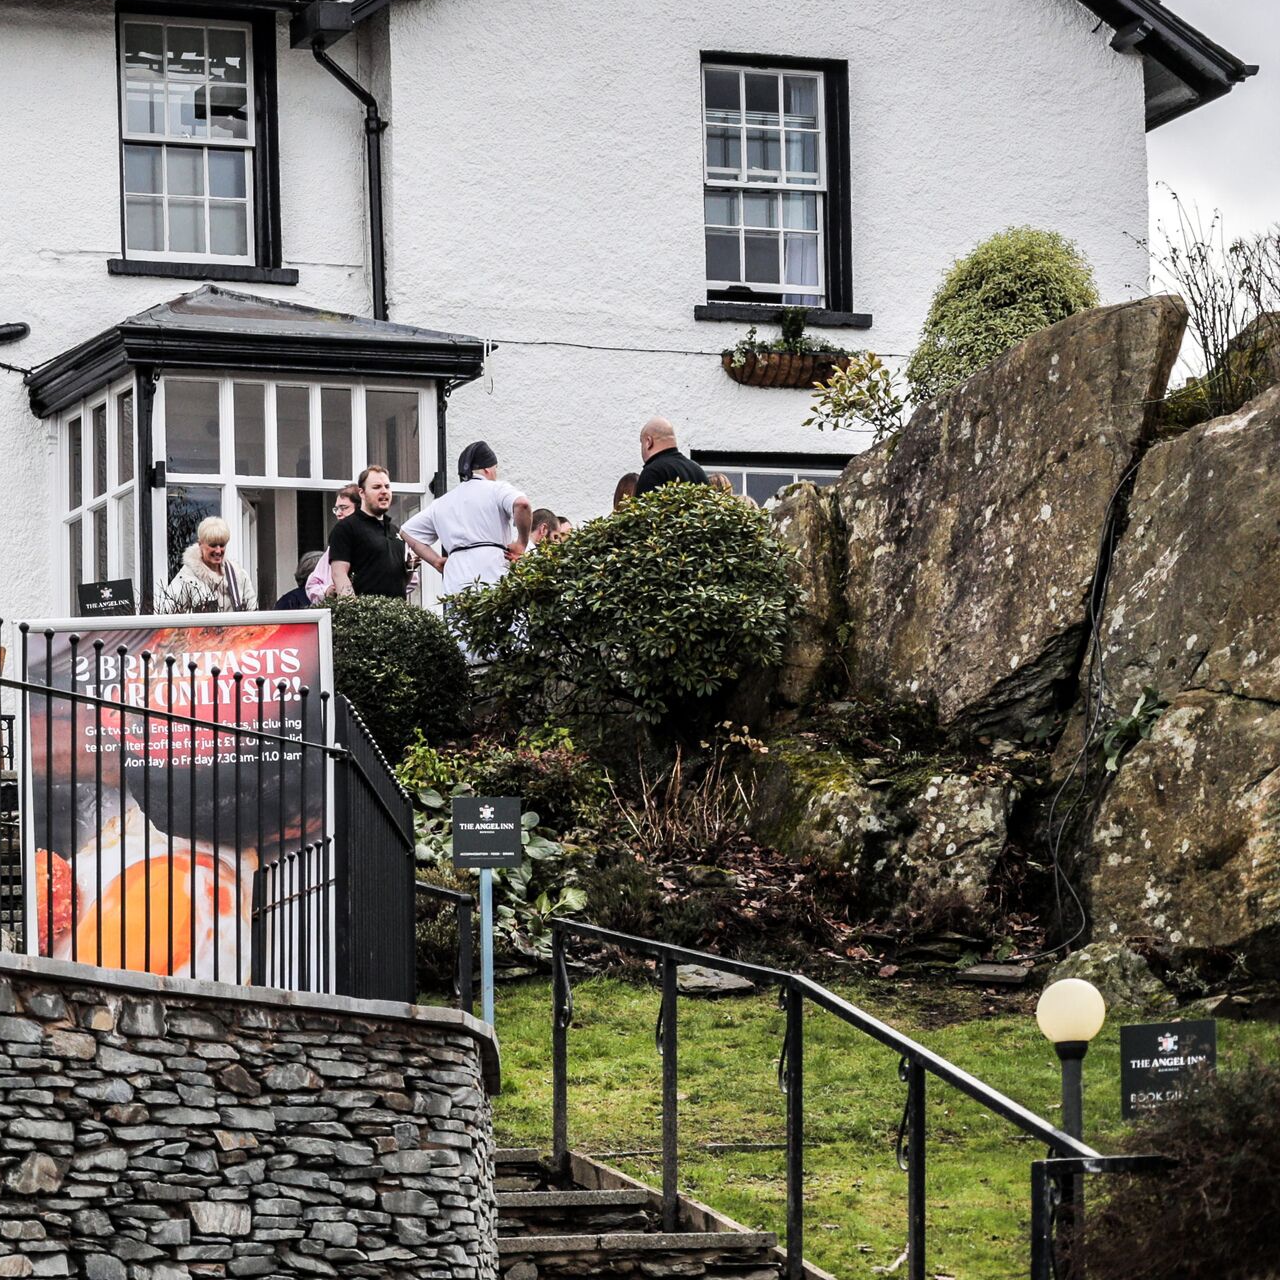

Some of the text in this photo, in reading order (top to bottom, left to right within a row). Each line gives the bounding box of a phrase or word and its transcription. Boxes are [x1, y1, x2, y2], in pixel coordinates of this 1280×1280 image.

[70, 647, 301, 681] 2 BREAKFASTS
[154, 677, 237, 707] ONLY
[242, 676, 302, 704] £12!
[85, 725, 105, 736] Gt
[105, 743, 117, 752] or
[118, 740, 145, 751] lter
[181, 753, 214, 767] Frday
[1130, 1059, 1150, 1069] THE
[1152, 1056, 1185, 1067] ANGEL
